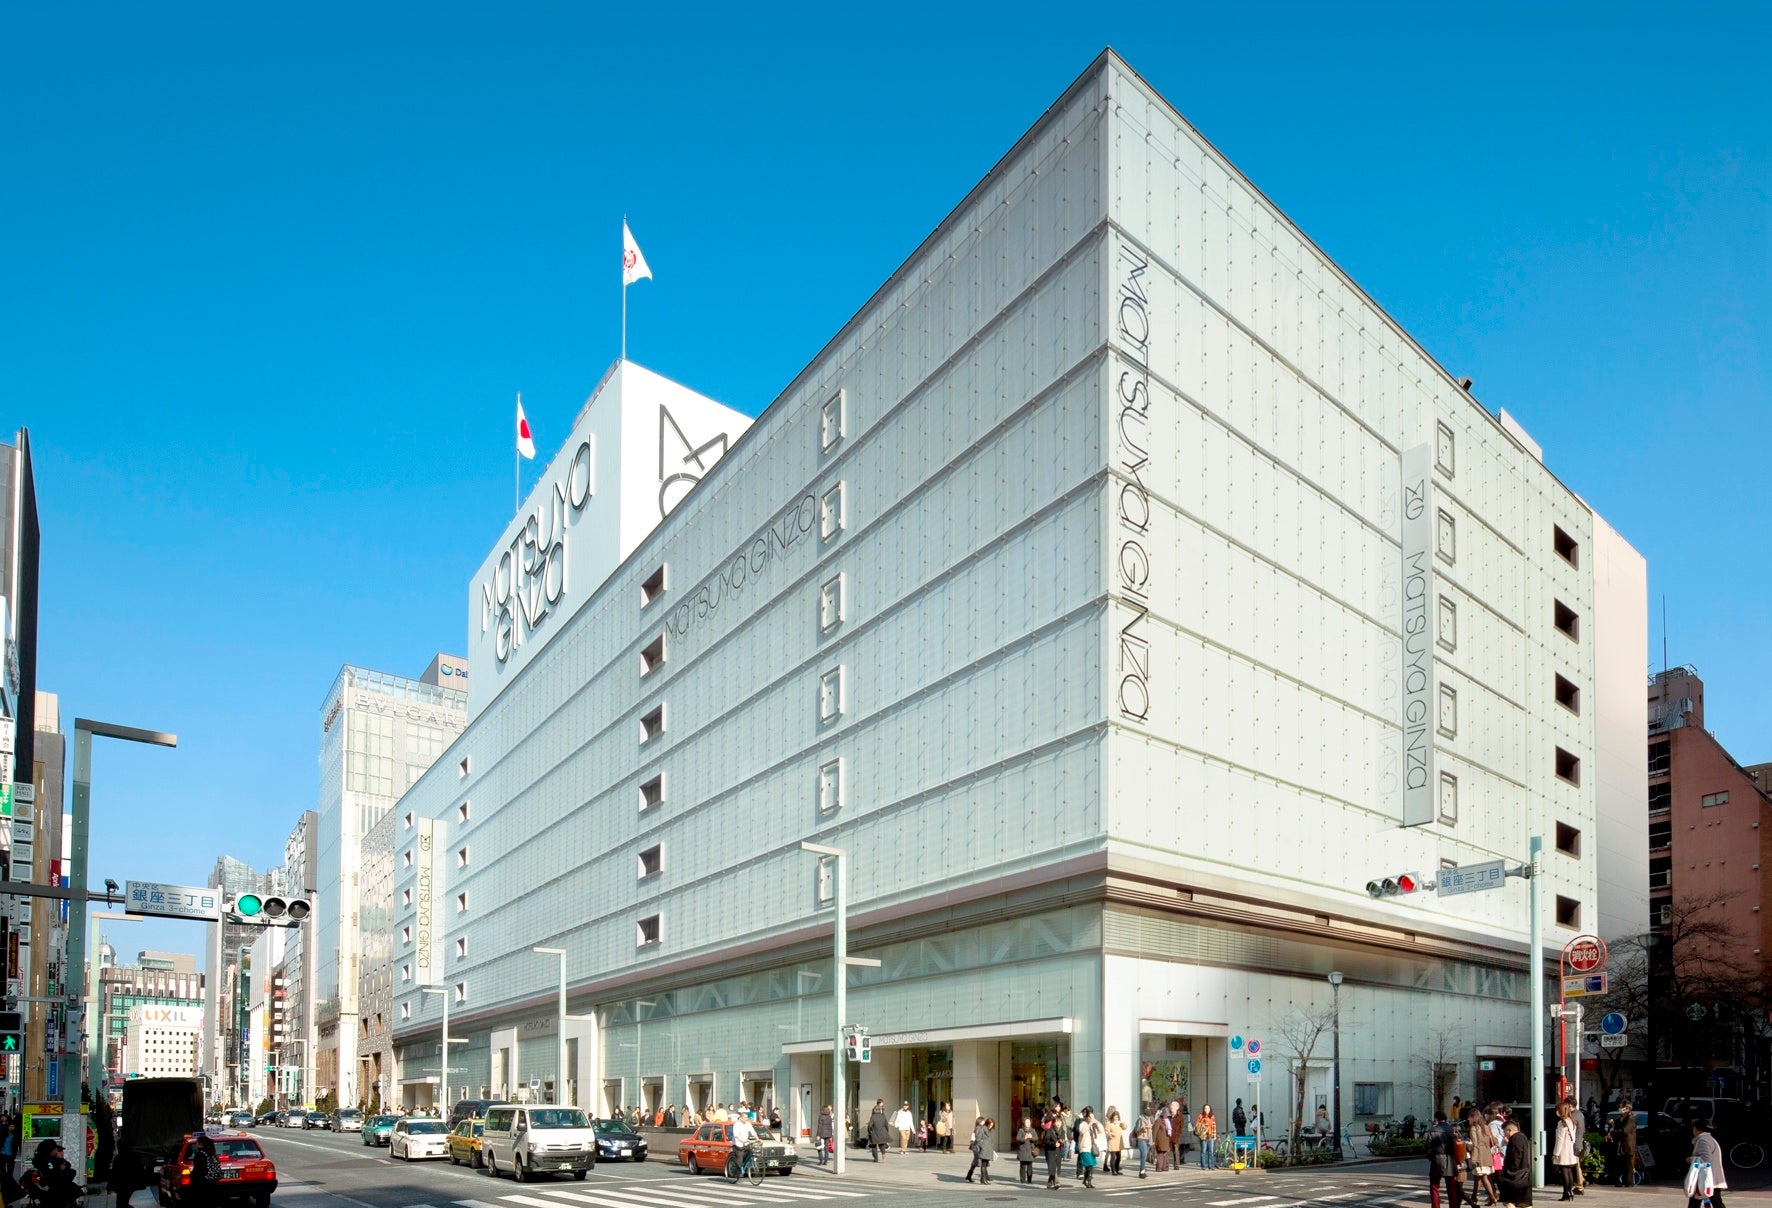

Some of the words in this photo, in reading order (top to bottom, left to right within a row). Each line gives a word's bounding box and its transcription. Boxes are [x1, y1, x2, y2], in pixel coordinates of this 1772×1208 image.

[1441, 867, 1500, 888] 銀座三丁目
[132, 882, 159, 891] 中央区
[132, 889, 214, 909] 銀座三丁目
[141, 901, 165, 911] Ginza
[168, 905, 206, 915] 3-chome
[1572, 948, 1598, 963] 消火栓
[145, 1009, 187, 1022] LIXIL
